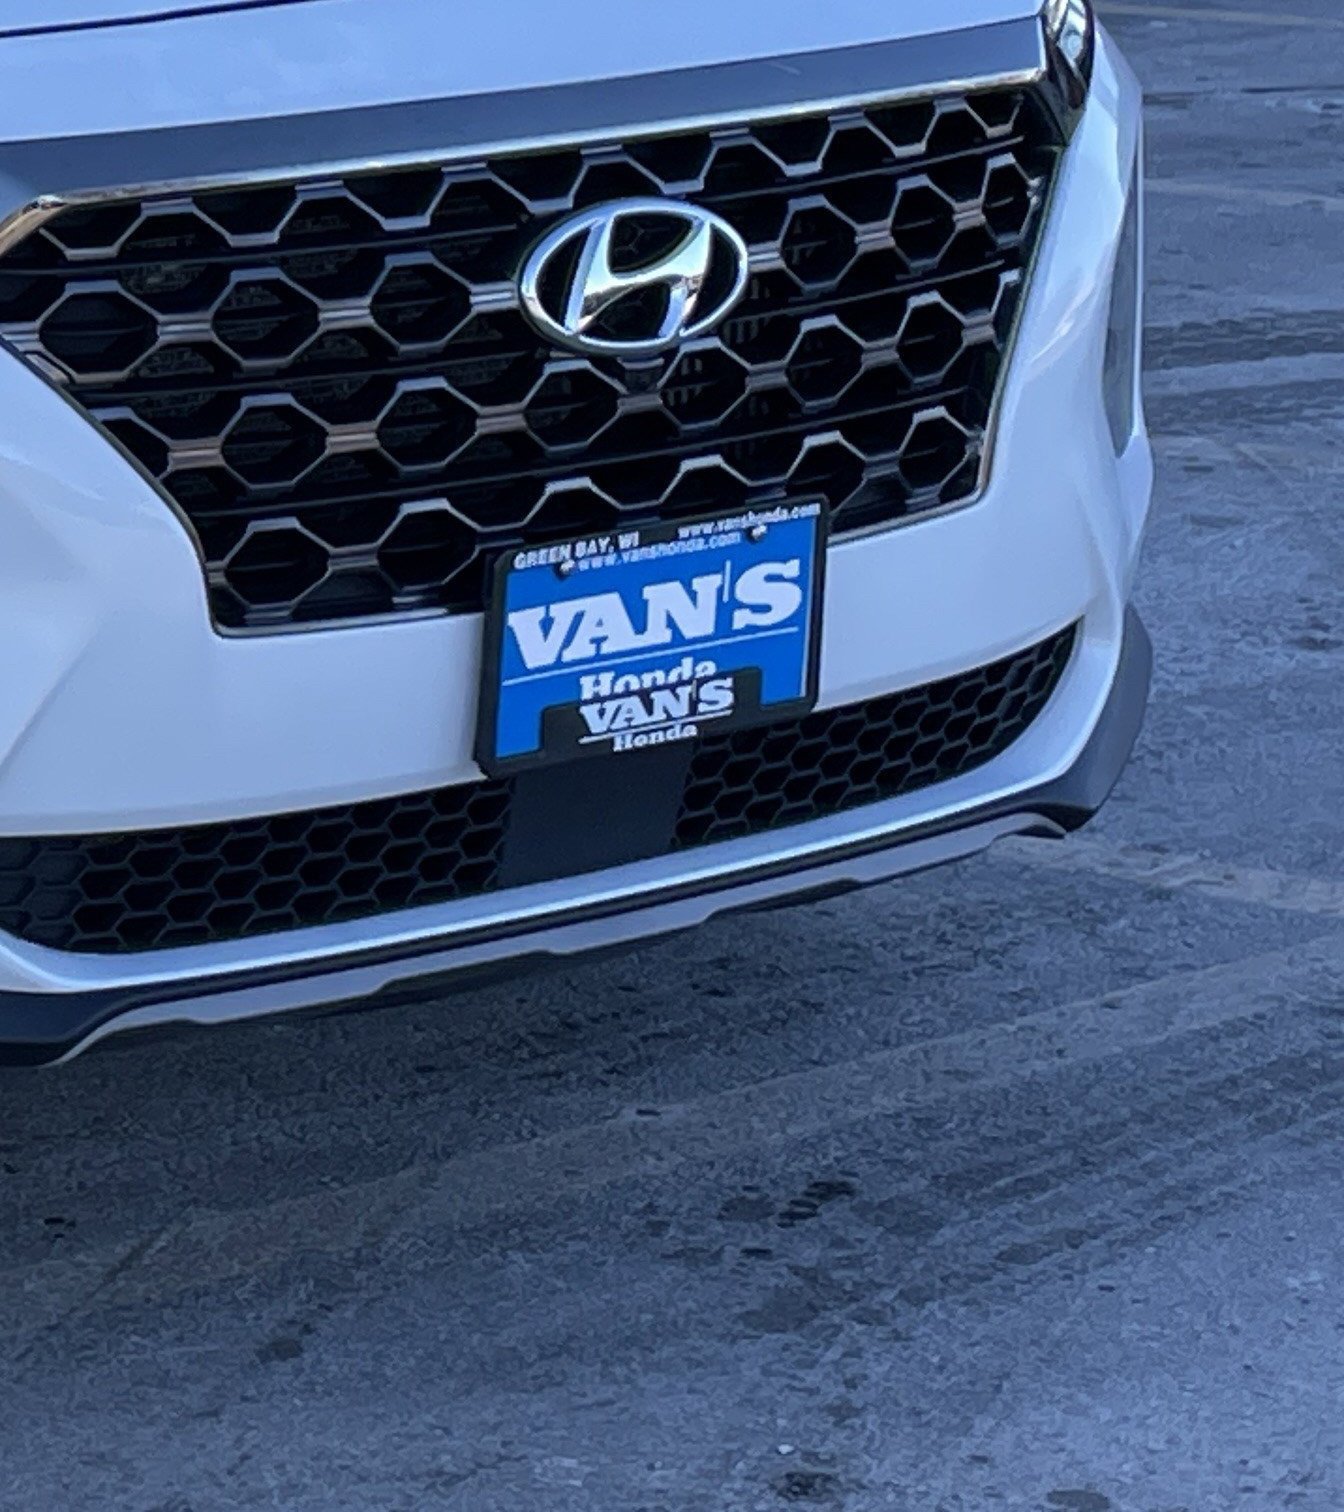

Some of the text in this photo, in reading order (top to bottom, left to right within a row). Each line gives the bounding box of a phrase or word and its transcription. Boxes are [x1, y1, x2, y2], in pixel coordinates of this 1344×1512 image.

[513, 543, 572, 570] GREEN
[617, 530, 640, 550] WI
[507, 558, 803, 670] VAN'S
[579, 656, 718, 701] Honda
[579, 677, 735, 735] VAN'S
[613, 723, 699, 753] Honda
